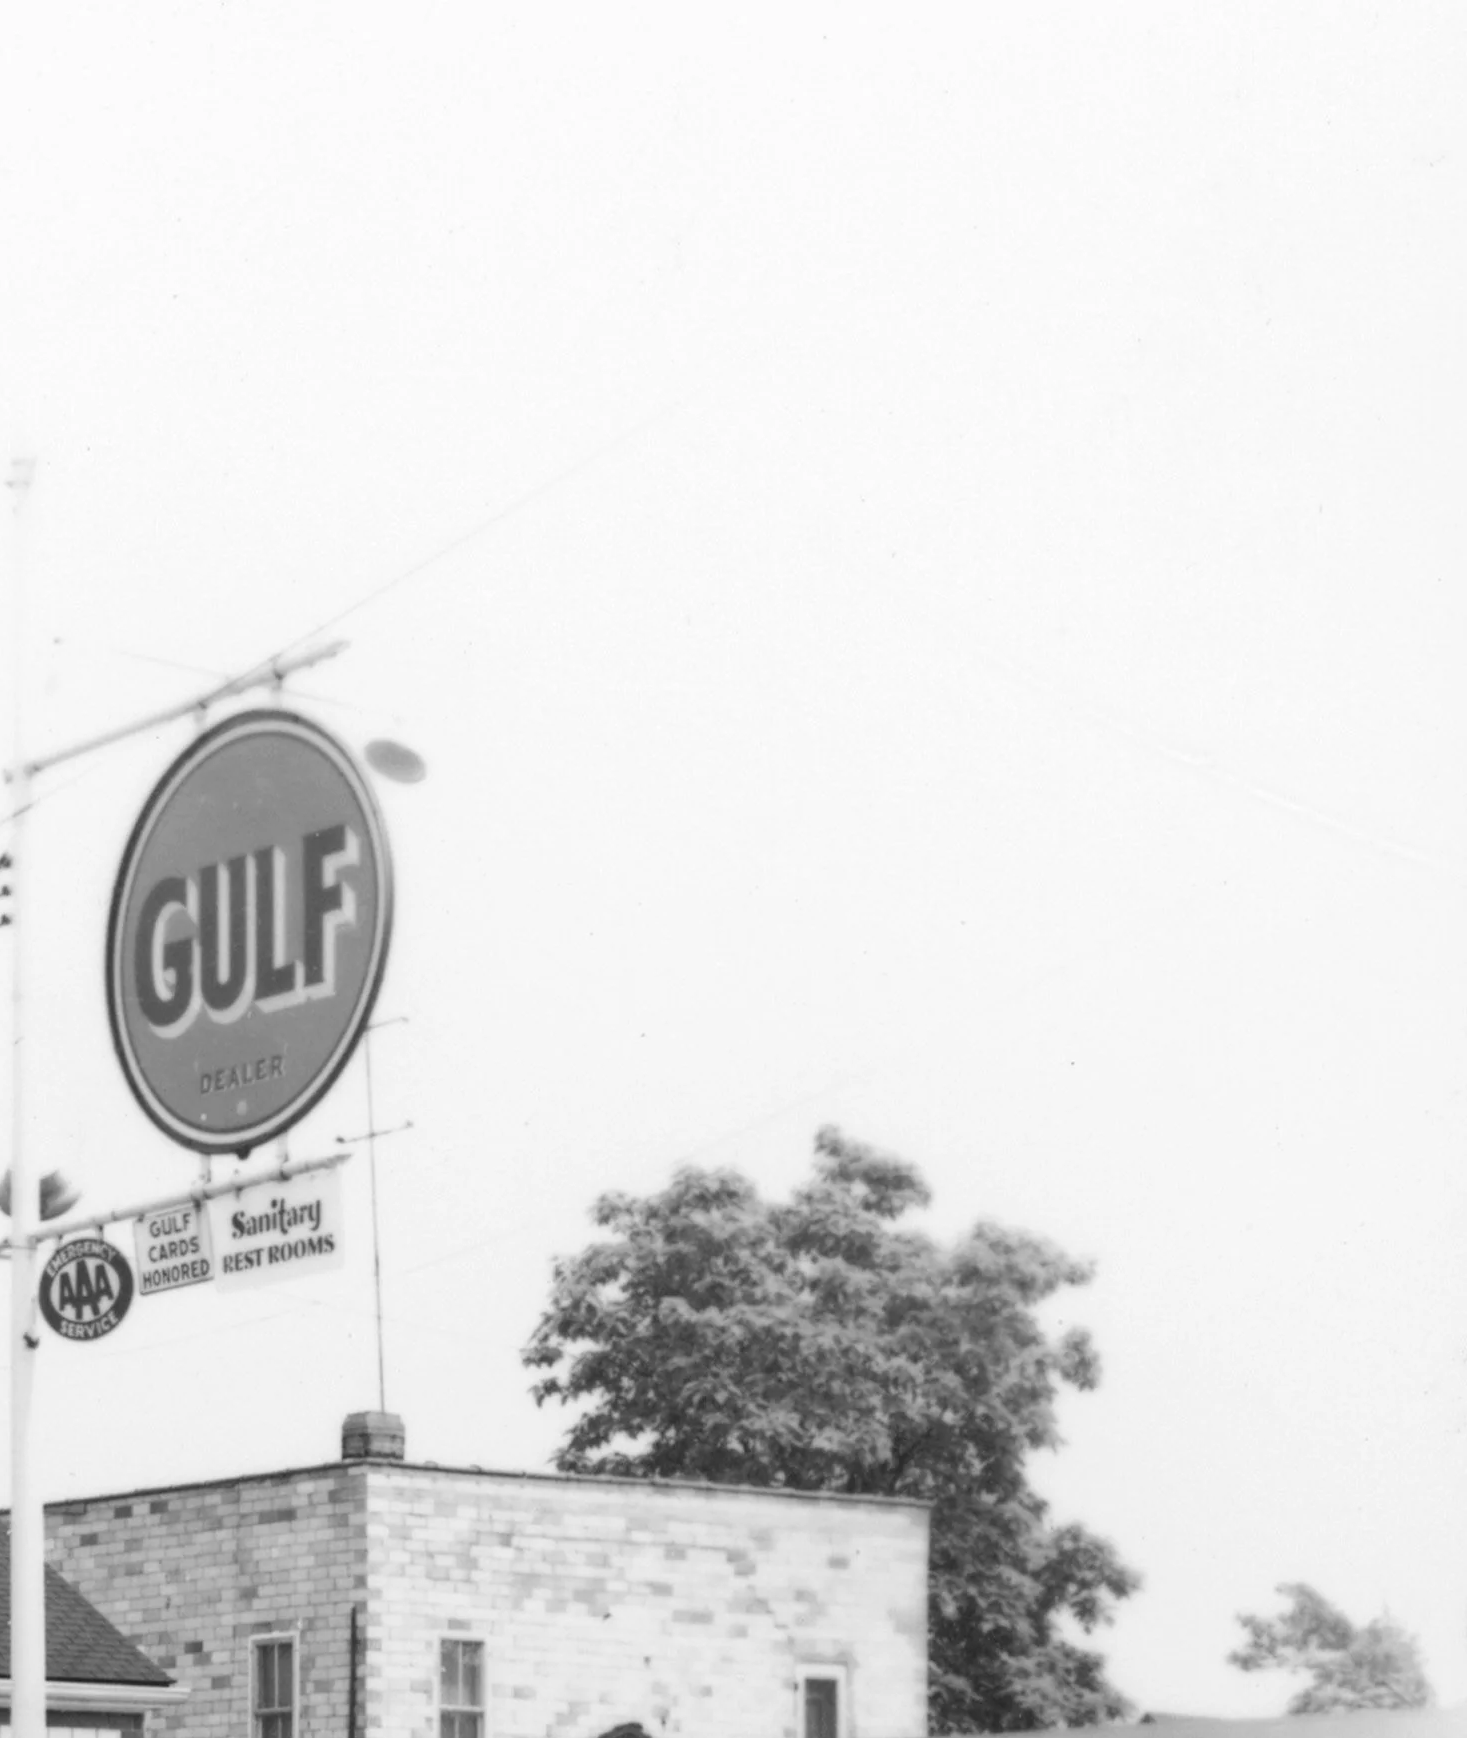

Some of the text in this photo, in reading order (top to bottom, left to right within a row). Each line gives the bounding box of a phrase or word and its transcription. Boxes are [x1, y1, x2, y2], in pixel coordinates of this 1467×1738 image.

[134, 824, 359, 1040] GULF
[200, 1055, 284, 1094] DEALER
[149, 1212, 191, 1238] GULF
[231, 1198, 321, 1239] Sanitary
[46, 1241, 117, 1278] EMERGENCY
[148, 1236, 200, 1263] CARDS
[222, 1234, 335, 1274] REST ROOMS
[59, 1259, 114, 1320] AAA
[143, 1258, 210, 1289] HONORED
[60, 1311, 118, 1338] SERVICE
